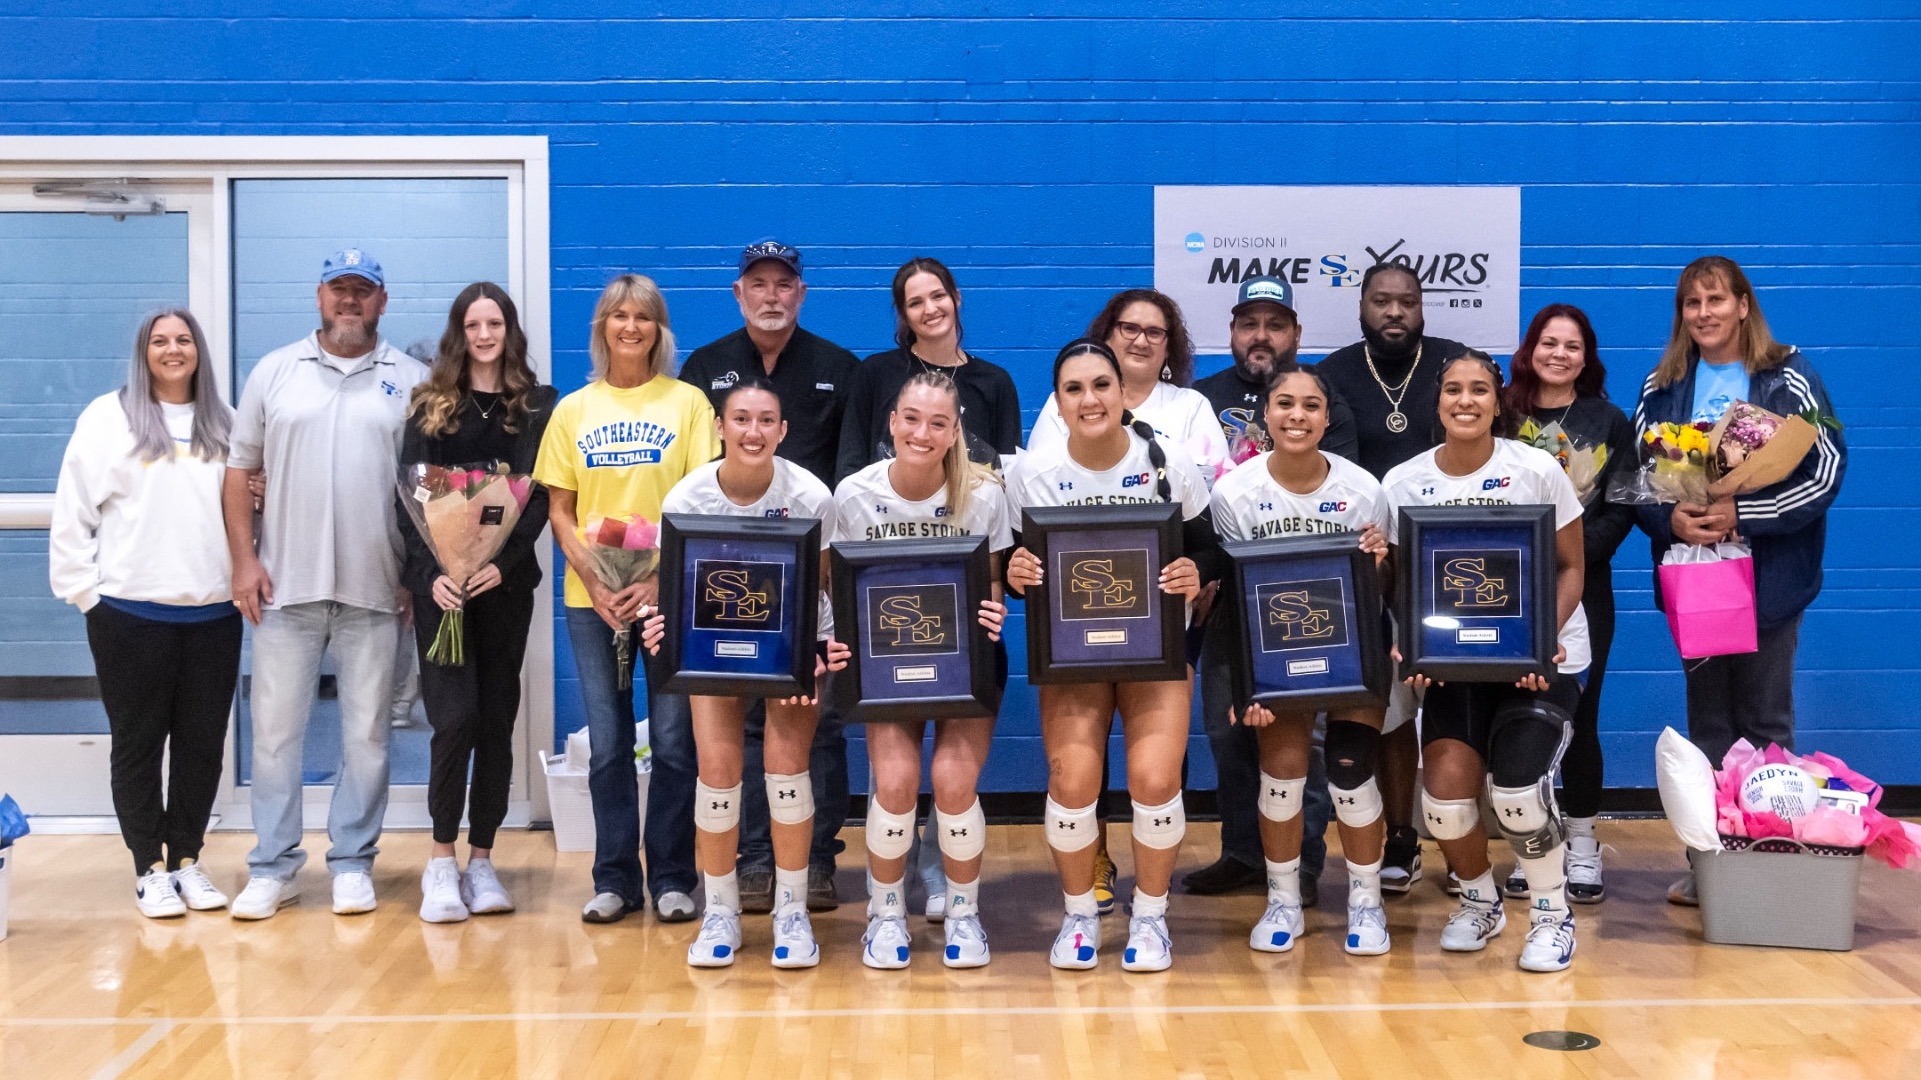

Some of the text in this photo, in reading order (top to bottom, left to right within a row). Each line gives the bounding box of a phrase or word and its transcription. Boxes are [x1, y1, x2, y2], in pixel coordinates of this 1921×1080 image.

[1213, 237, 1287, 249] DIVISION II
[1207, 257, 1312, 284] MAKE
[1320, 254, 1362, 288] SE
[577, 421, 676, 455] SOUTHEASTERN
[591, 450, 654, 466] VOLLEYBALL
[1122, 472, 1149, 488] GAC
[1482, 476, 1511, 491] GAC
[934, 506, 955, 518] GA
[1319, 501, 1347, 513] GAC
[866, 523, 917, 541] SAVAGE
[1251, 517, 1301, 540] SAVAGE
[1071, 559, 1137, 610] SE
[1443, 557, 1509, 607] SE
[706, 569, 770, 622] SE
[879, 595, 945, 646] SE
[1269, 590, 1335, 641] SE
[1744, 768, 1799, 790] JAEDYN
